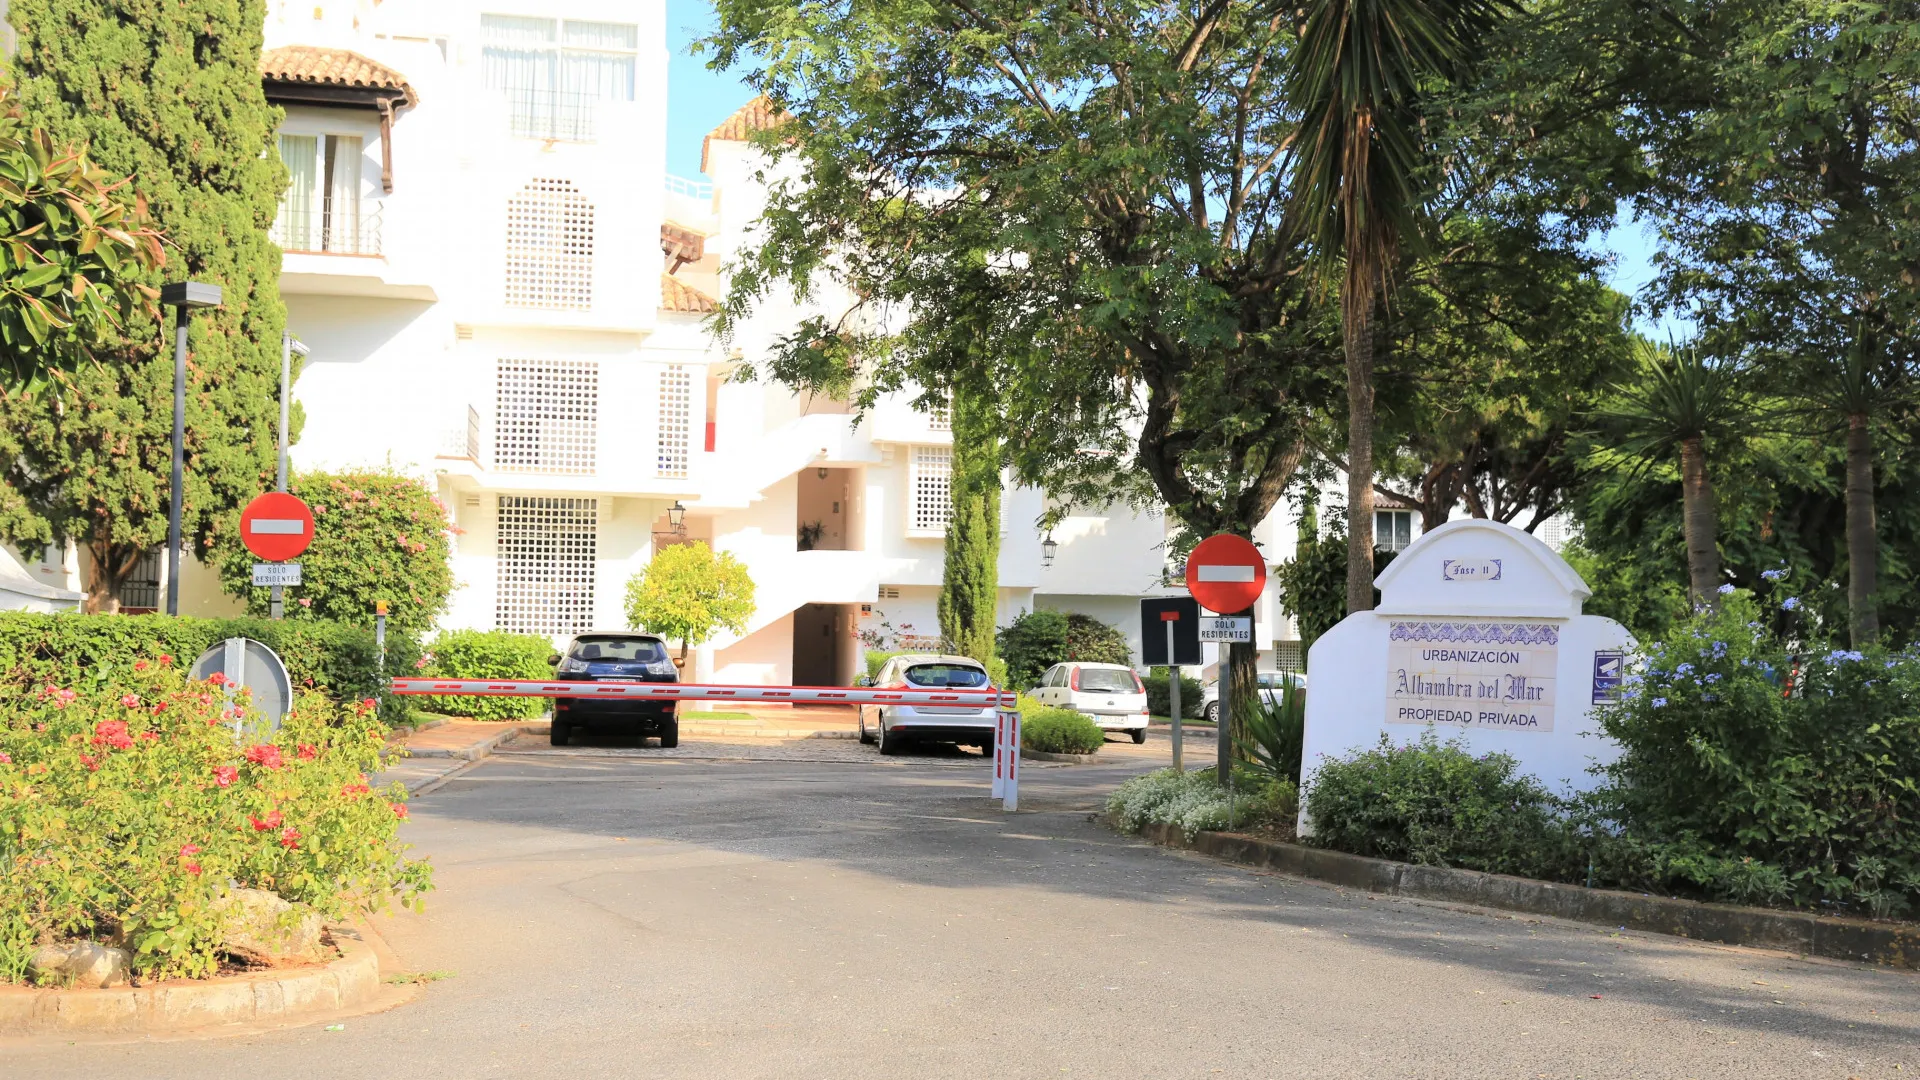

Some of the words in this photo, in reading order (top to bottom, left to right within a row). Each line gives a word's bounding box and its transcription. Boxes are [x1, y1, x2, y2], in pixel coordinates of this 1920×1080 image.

[1453, 565, 1475, 575] Fase
[255, 575, 300, 583] RESIDENTES
[1215, 620, 1235, 629] SOLO
[1201, 630, 1249, 639] RESIDENTES
[1422, 649, 1520, 664] URBANIZACIÓN
[1394, 668, 1472, 701] Alhambra
[1478, 679, 1499, 699] del
[1502, 673, 1544, 707] Mar
[1398, 707, 1473, 723] PROPIEDAD
[1479, 711, 1538, 727] PRIVADA
